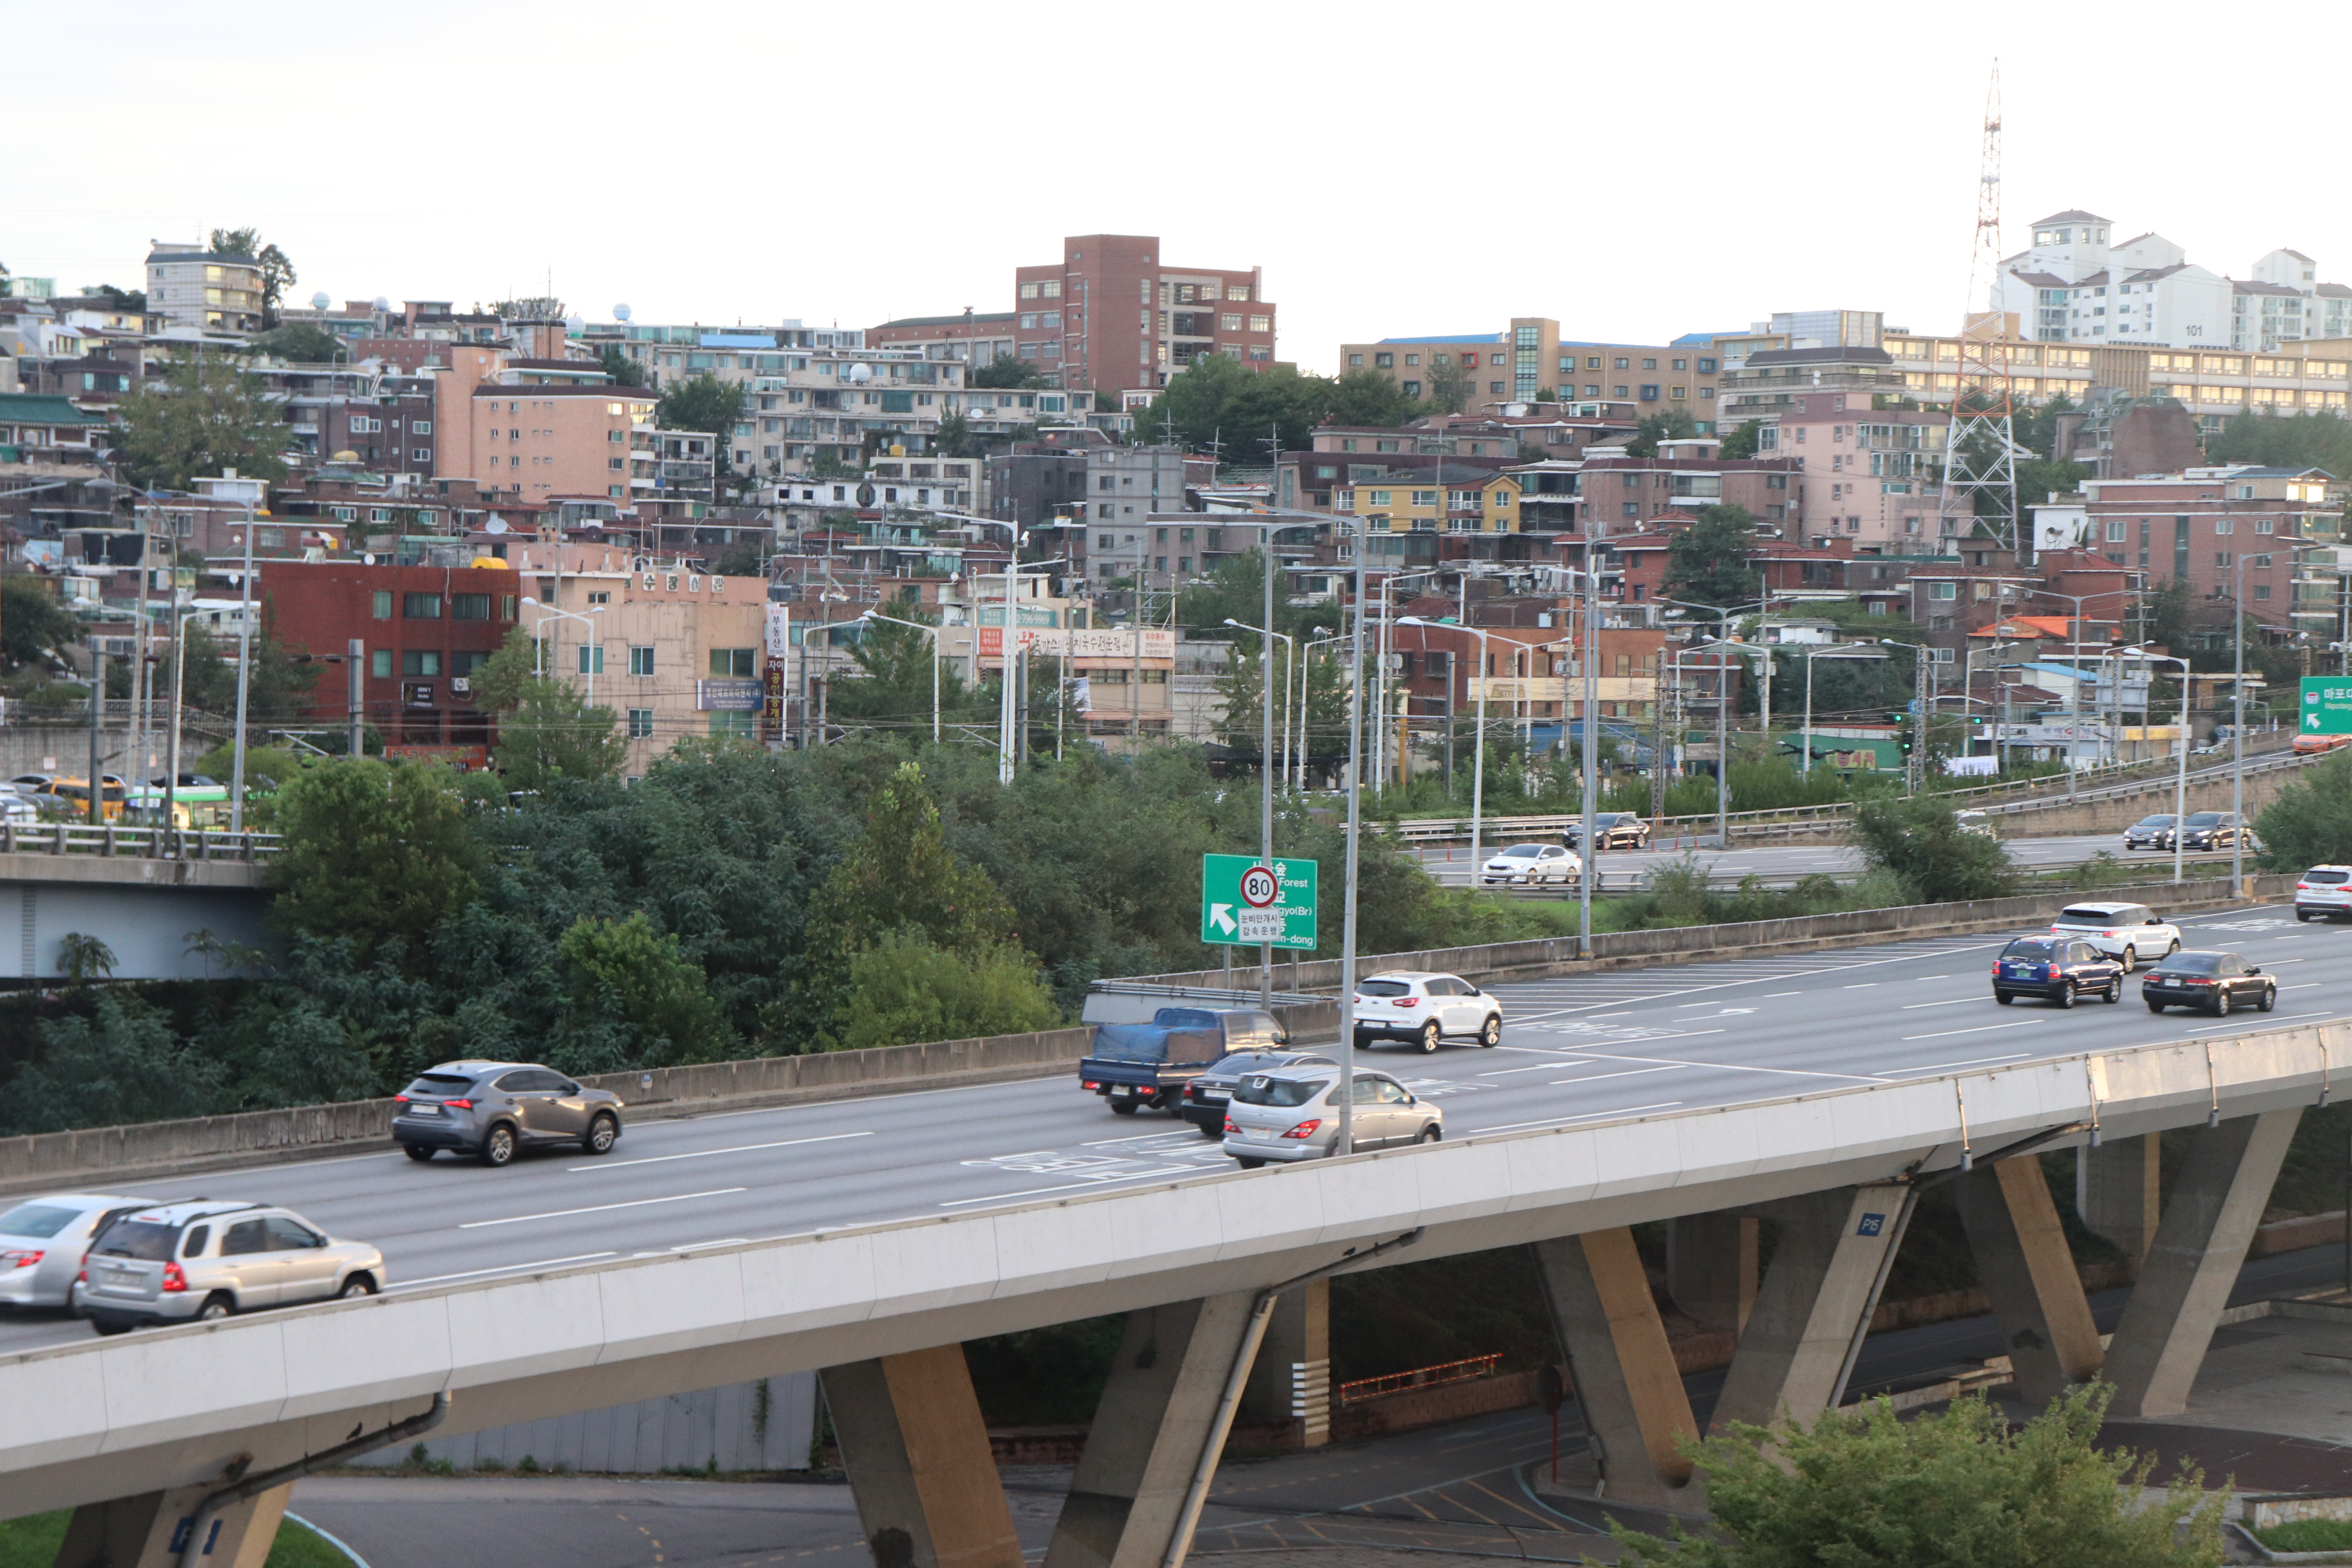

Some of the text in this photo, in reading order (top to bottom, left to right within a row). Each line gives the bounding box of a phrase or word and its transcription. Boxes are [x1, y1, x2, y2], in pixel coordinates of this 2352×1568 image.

[2186, 325, 2202, 336] 101
[1017, 613, 1050, 624] 2-796-9969
[768, 660, 784, 671] 자이
[1249, 878, 1270, 896] 80
[1279, 877, 1308, 888] Forest
[1241, 914, 1277, 923] 눈비안개시
[1861, 1218, 1880, 1231] P15
